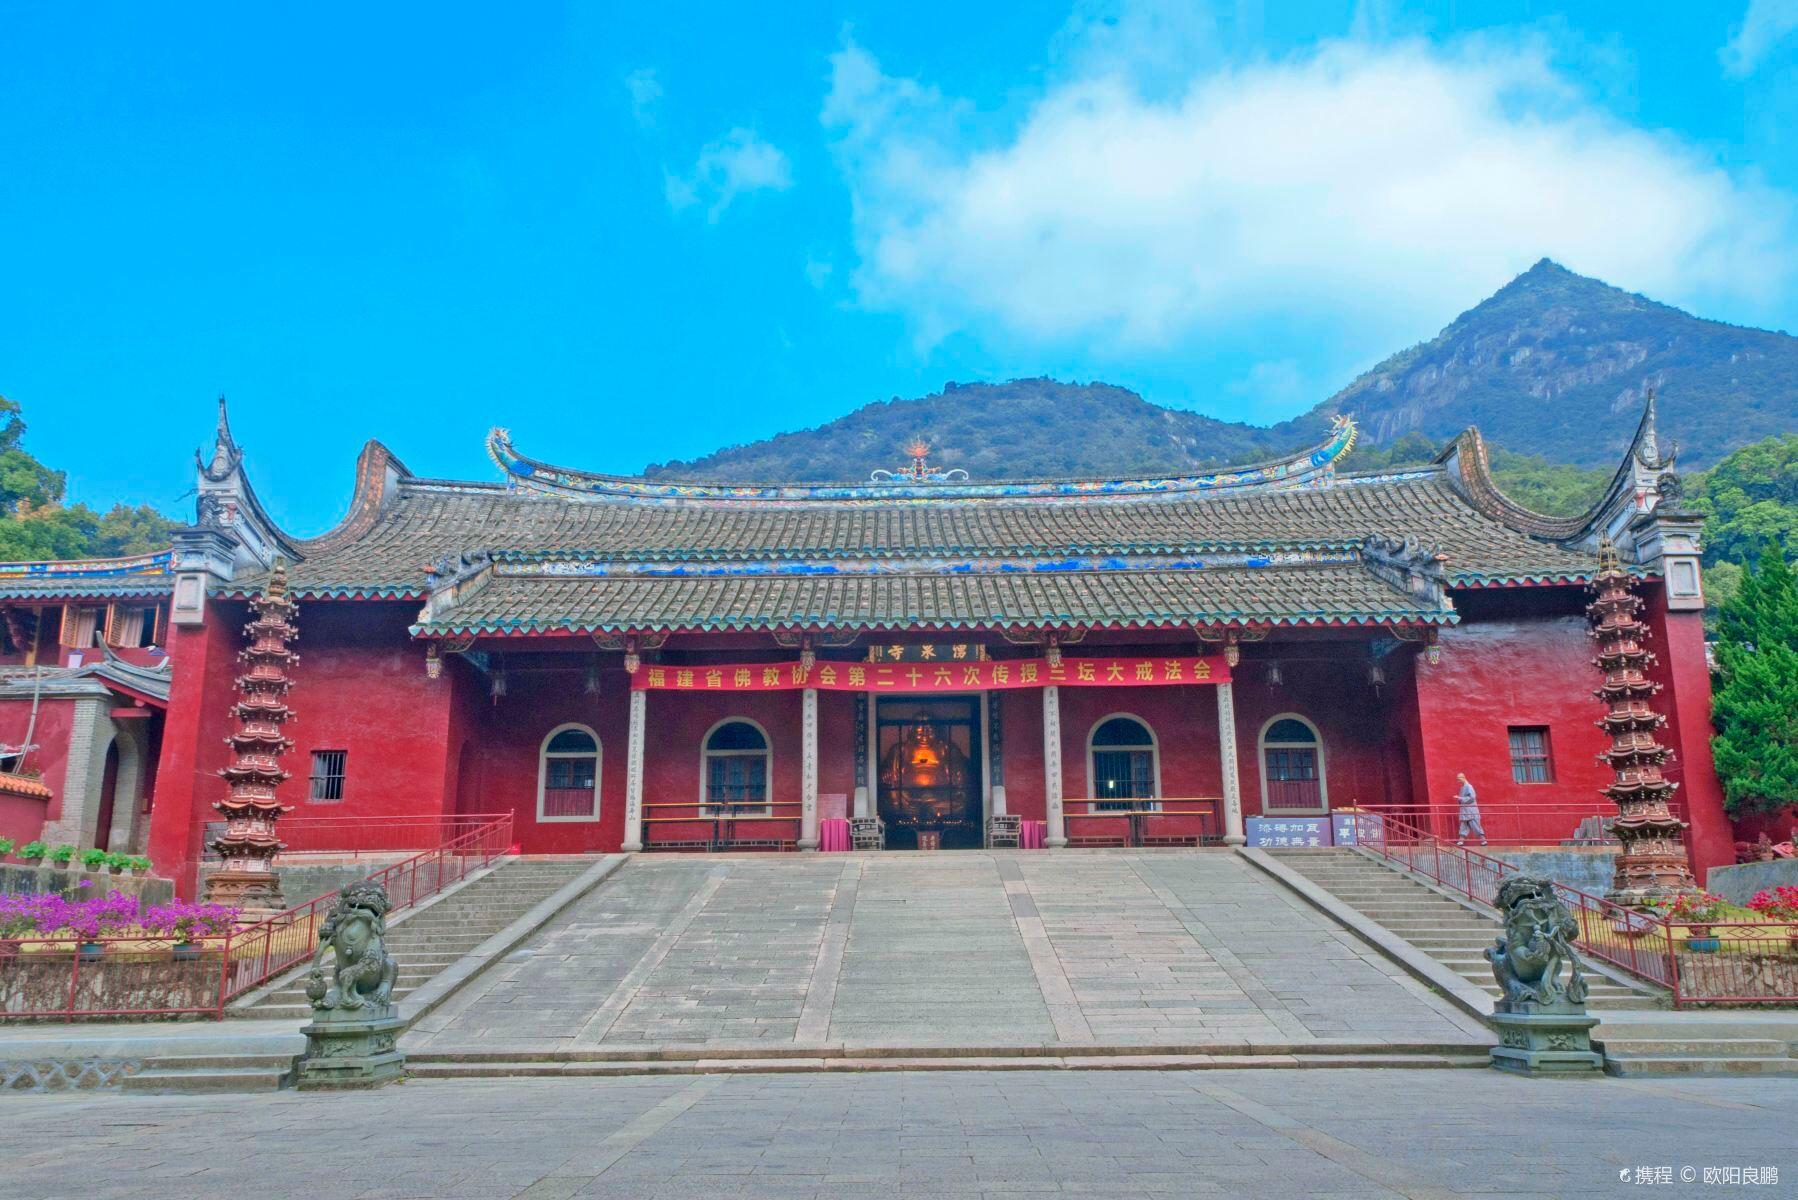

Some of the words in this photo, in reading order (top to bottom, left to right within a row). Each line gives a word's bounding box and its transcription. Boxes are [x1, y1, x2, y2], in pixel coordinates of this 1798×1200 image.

[648, 660, 1211, 687] 福建省佛教协会第二十六次传授三坛大戒法会
